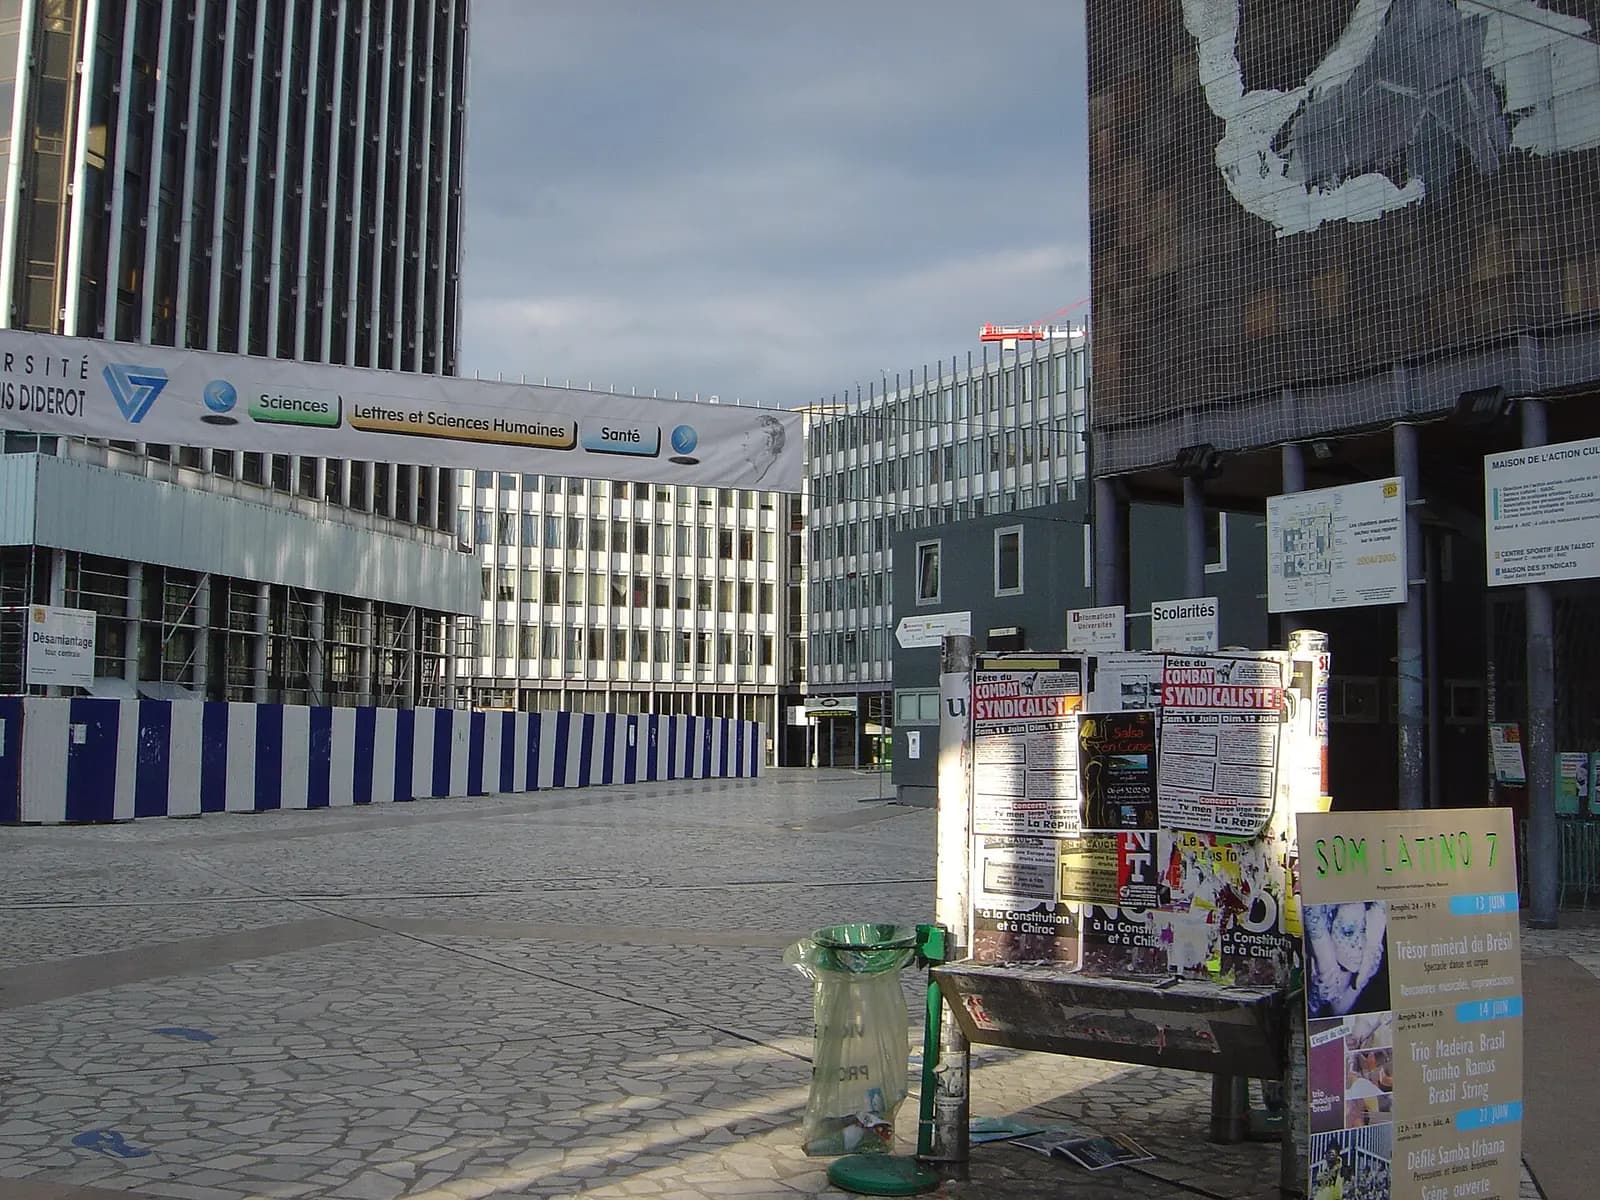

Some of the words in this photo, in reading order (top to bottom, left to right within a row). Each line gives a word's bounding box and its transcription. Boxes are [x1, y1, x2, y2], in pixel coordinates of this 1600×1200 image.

[19, 384, 86, 417] DIDEROT
[260, 394, 329, 414] Sciences
[354, 404, 404, 422] Lettres
[409, 411, 424, 423] et
[427, 411, 489, 430] Sciences
[494, 418, 565, 438] Humaines
[601, 427, 640, 443] Santé
[1492, 457, 1526, 470] MAISON
[1527, 455, 1539, 464] DE
[1541, 449, 1580, 462] L'ACTION
[1501, 548, 1525, 557] CENTRE
[1526, 546, 1552, 554] SPORTIF
[1553, 544, 1569, 552] JEAN
[1541, 561, 1577, 571] SYNDICATS
[1153, 602, 1215, 621] Scolarités
[32, 631, 93, 650] Désamiantage
[1167, 659, 1192, 667] Fête
[1193, 659, 1207, 667] du
[977, 674, 998, 682] Fête
[1000, 673, 1012, 681] du
[1165, 668, 1214, 685] COMBAT
[975, 682, 1019, 699] COMBAT
[1165, 686, 1273, 708] SYNDICALISTE
[976, 697, 1065, 719] SYNDICALIST
[1258, 715, 1279, 723] Juin
[1113, 724, 1145, 738] Salsa
[1215, 815, 1229, 824] La
[1315, 835, 1368, 878] SOM
[1381, 831, 1472, 876] LATINO
[1486, 832, 1497, 868] 7
[1475, 896, 1485, 910] 13
[993, 910, 1003, 919] la
[1006, 909, 1070, 925] Constitution
[1093, 919, 1101, 930] à
[1104, 920, 1114, 931] la
[997, 922, 1008, 931] et
[1011, 922, 1018, 931] à
[1021, 922, 1055, 935] Chirac
[1108, 934, 1120, 943] et
[1122, 934, 1130, 945] à
[1395, 940, 1428, 960] Trésor
[1431, 936, 1468, 957] minéral
[1471, 936, 1484, 953] du
[1487, 932, 1513, 952] Brésil
[1223, 944, 1235, 954] et
[1239, 944, 1247, 955] à
[1411, 1042, 1430, 1061] Trio
[1435, 1037, 1474, 1058] Madeira
[1480, 1031, 1505, 1051] Brasil
[1421, 1063, 1460, 1084] Toninho
[1465, 1058, 1496, 1076] Ramos
[1429, 1086, 1456, 1105] Brasil
[1462, 1081, 1489, 1101] String
[1408, 1148, 1435, 1170] Défilé
[1438, 1145, 1470, 1166] Samba
[1472, 1139, 1505, 1158] Urbana
[1454, 1179, 1490, 1198] ouverte
